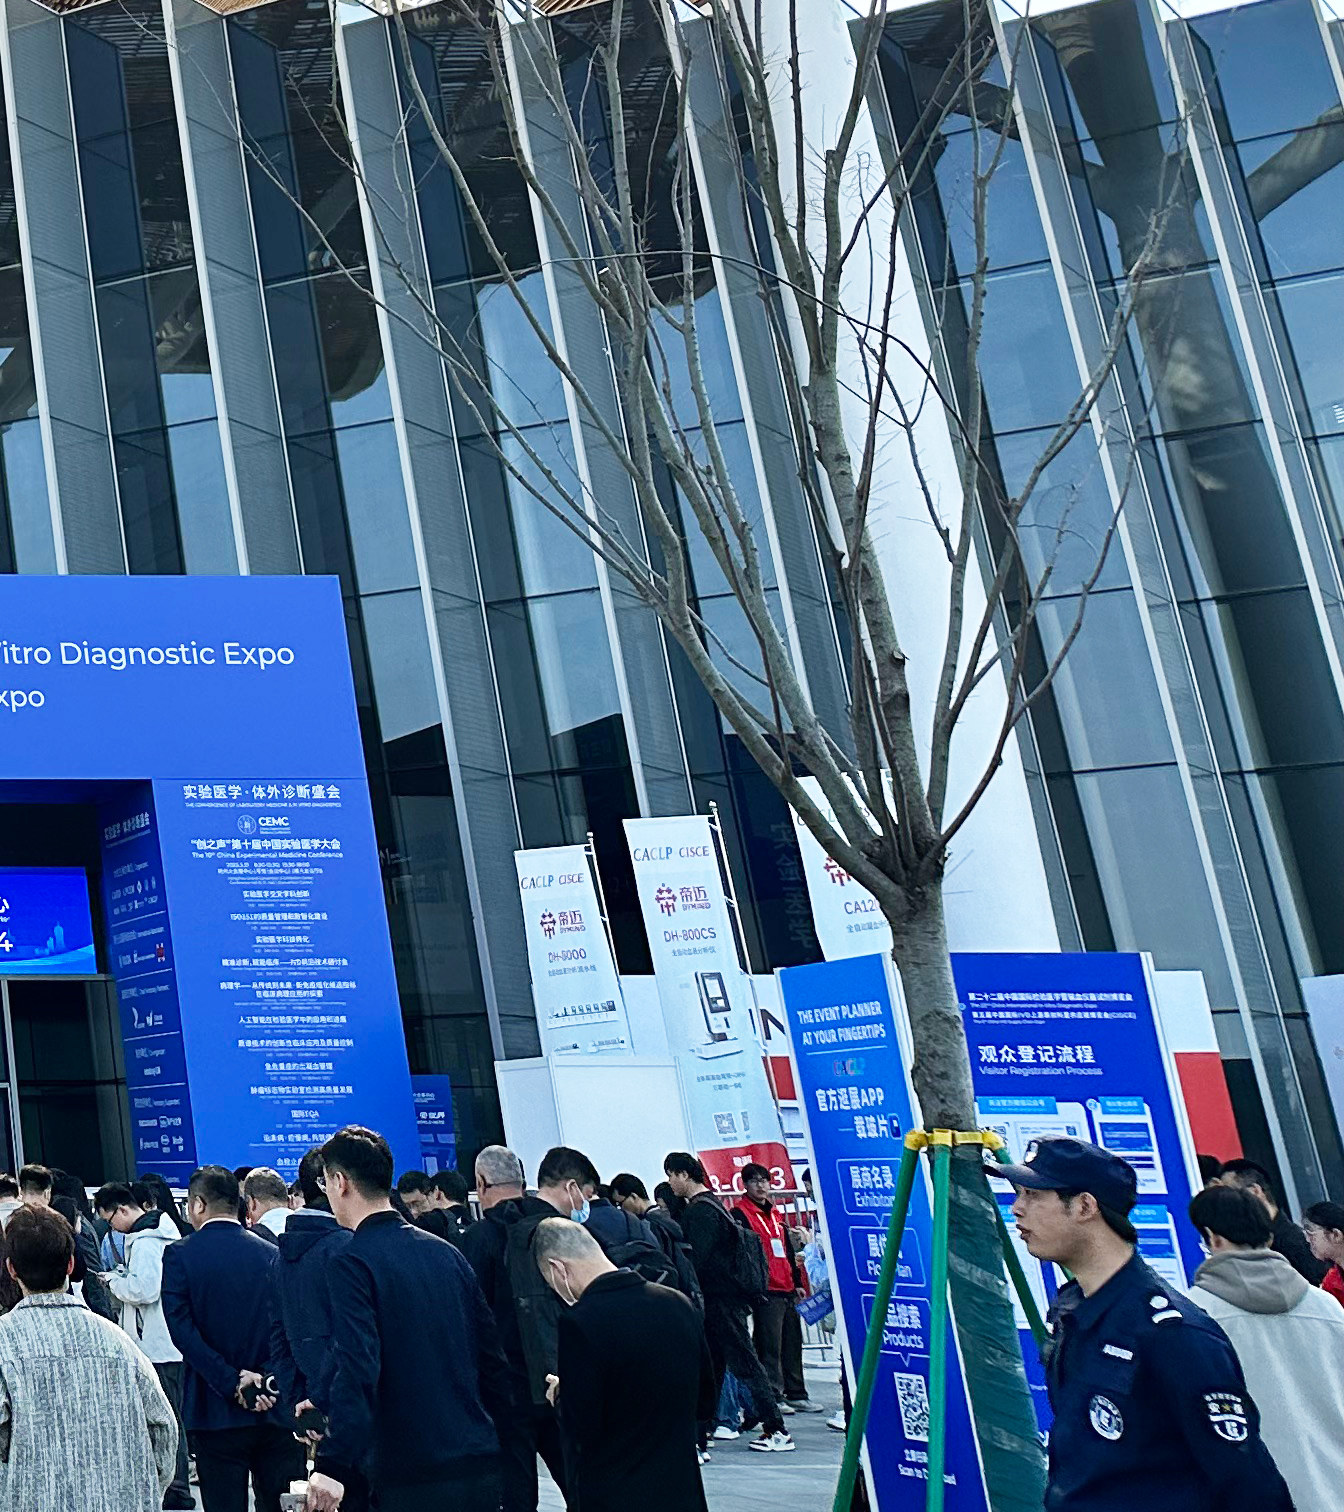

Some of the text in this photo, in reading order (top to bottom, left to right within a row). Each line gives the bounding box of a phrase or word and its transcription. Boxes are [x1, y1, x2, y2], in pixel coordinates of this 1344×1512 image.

[60, 640, 215, 671] Diagnostic
[223, 642, 295, 671] Expo
[183, 784, 341, 800] 实验医学·体外诊断盛会
[258, 817, 289, 827] CEMC
[633, 845, 710, 861] CACLP CISCE
[520, 874, 554, 890] CACLP
[664, 927, 717, 942] DH-800CS
[814, 1005, 840, 1022] EVENT
[841, 1000, 882, 1019] PLANNER
[813, 1028, 838, 1044] YOUR
[977, 1044, 1096, 1063] 观众登记流程
[979, 1065, 1009, 1075] Visitor
[1009, 1065, 1065, 1076] Registration
[883, 1330, 924, 1349] Products
